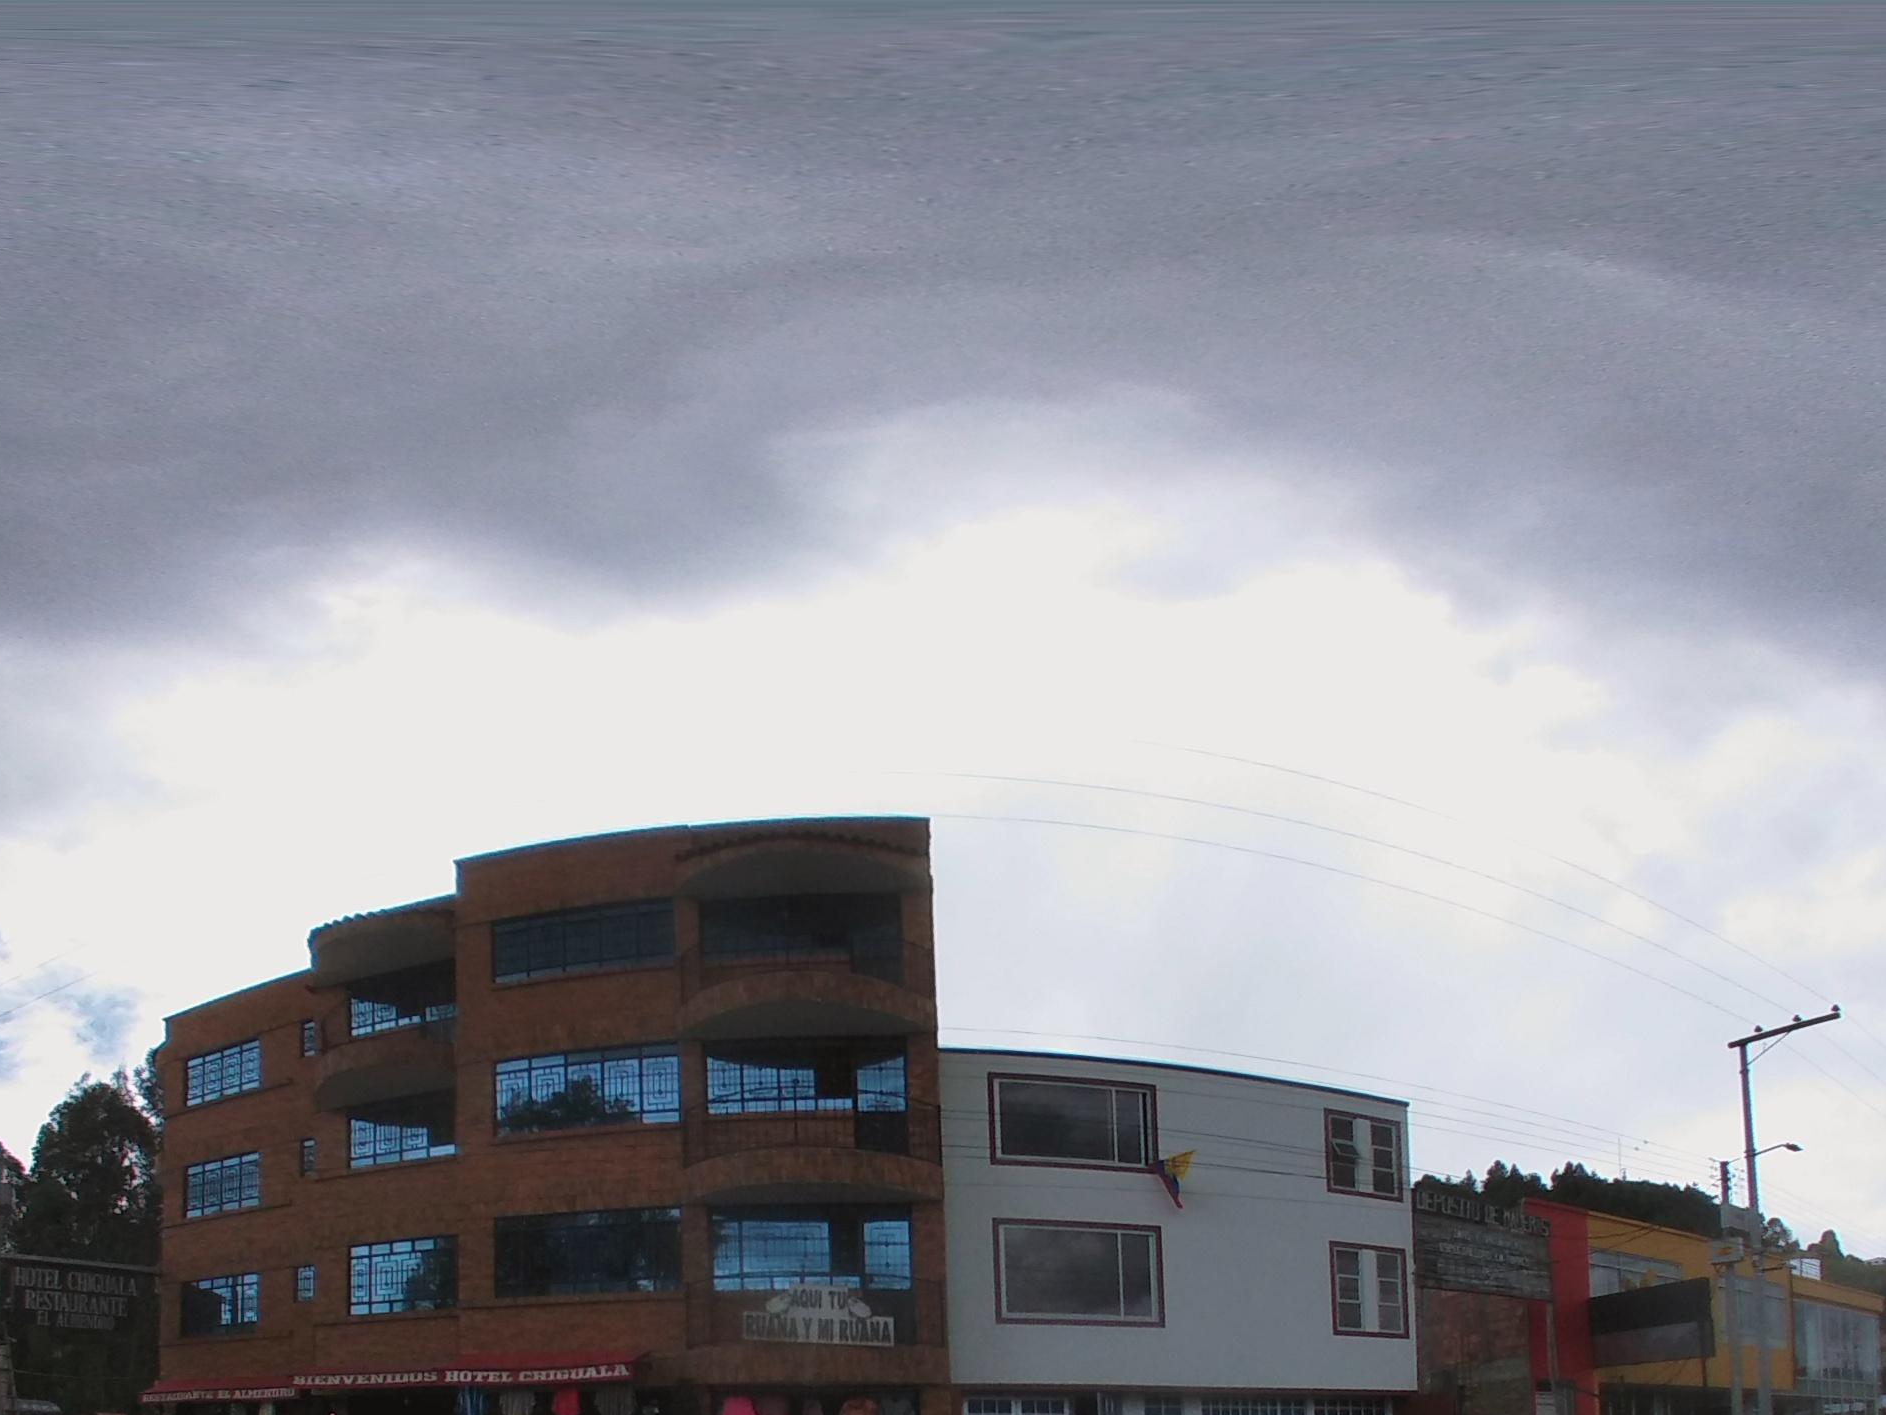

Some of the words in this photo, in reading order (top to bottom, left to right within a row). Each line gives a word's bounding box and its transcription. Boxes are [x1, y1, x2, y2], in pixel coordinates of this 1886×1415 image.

[14, 1266, 63, 1289] HOTEL
[68, 1271, 137, 1296] CHIGUALA
[24, 1289, 129, 1317] RESTAURANTE
[828, 1291, 847, 1310] TU
[745, 1313, 798, 1339] RUANA
[802, 1317, 813, 1340] Y
[817, 1318, 833, 1341] MI
[839, 1318, 892, 1343] RUANA
[293, 1371, 439, 1385] BIENVENIDOS
[444, 1370, 513, 1383] HOTEL
[142, 1389, 214, 1402] RESTAURANTE
[217, 1388, 231, 1399] EL
